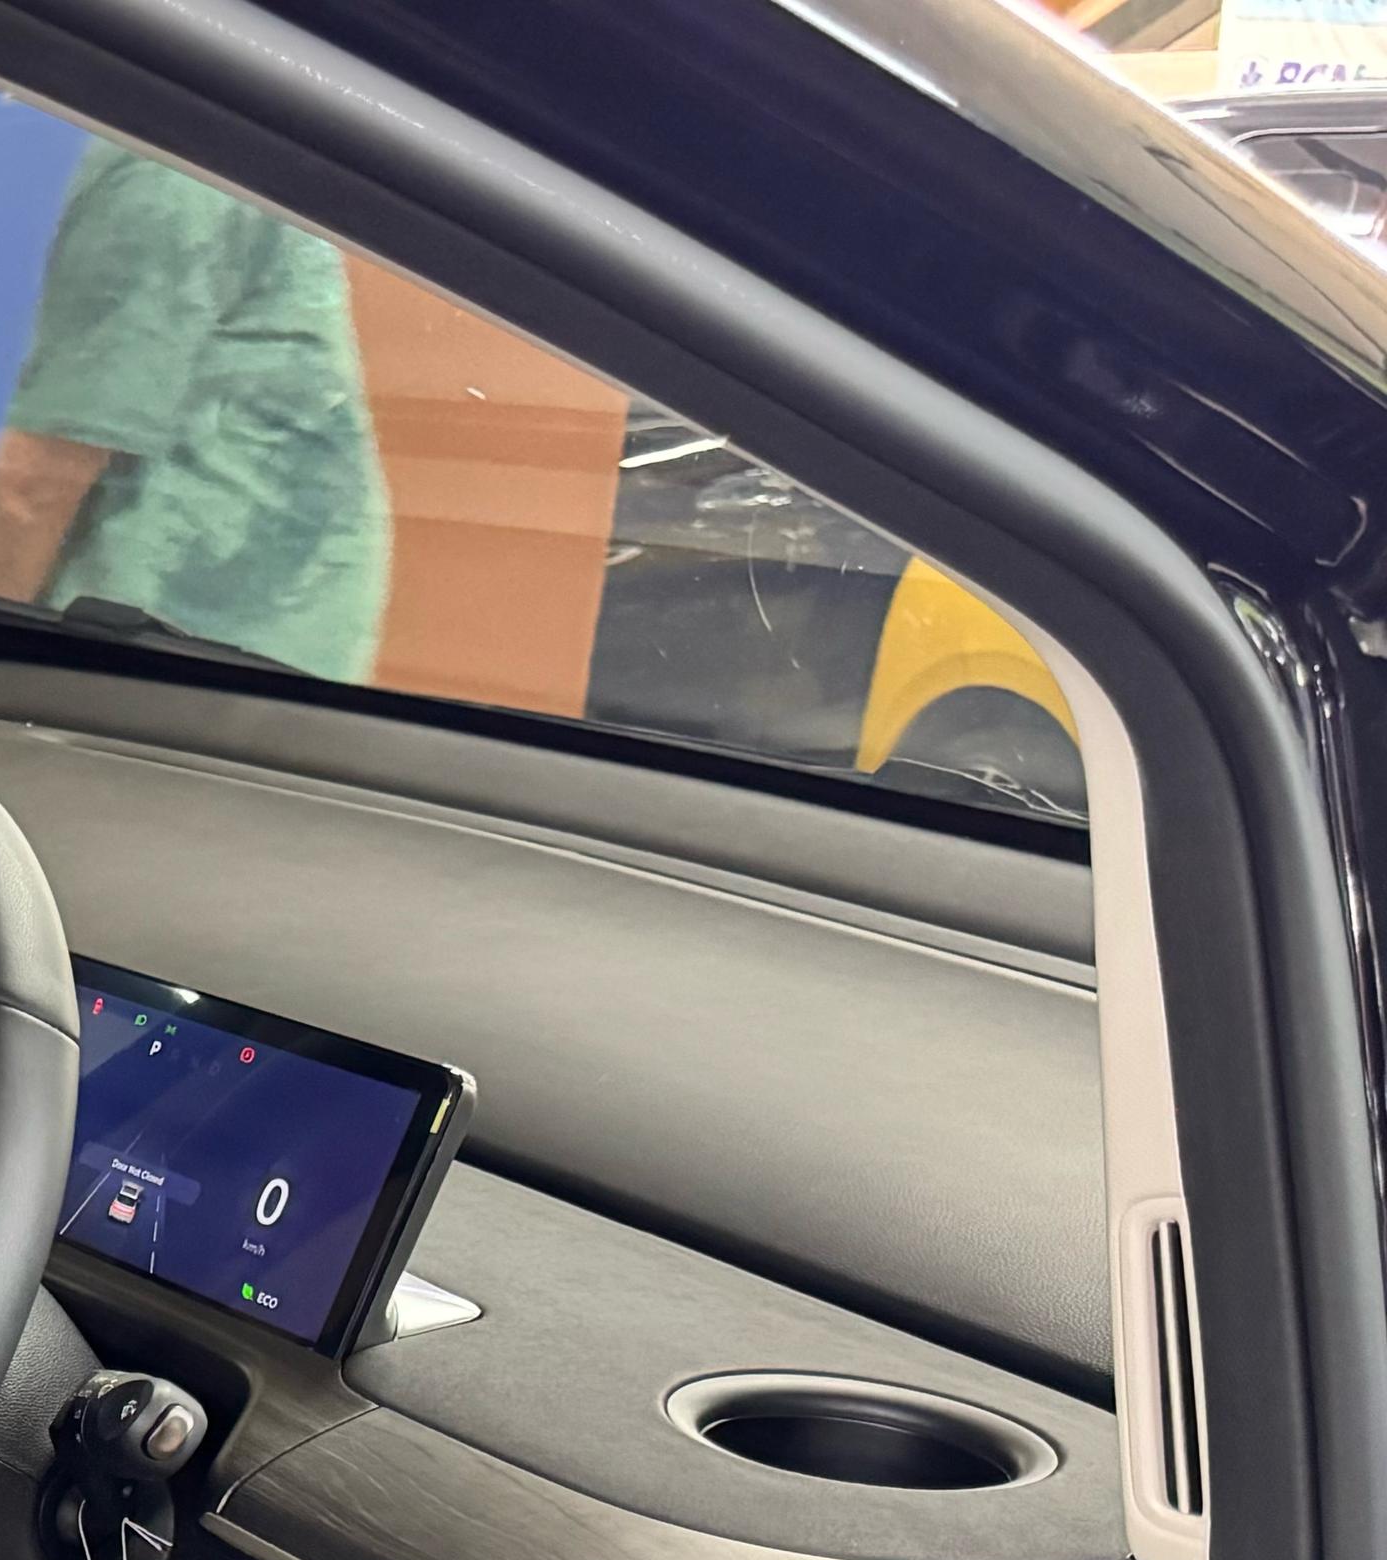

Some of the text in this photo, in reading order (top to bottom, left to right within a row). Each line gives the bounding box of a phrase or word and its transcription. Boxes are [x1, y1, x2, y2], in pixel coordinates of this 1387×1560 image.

[149, 1040, 162, 1056] P
[111, 1158, 165, 1186] Door Not Closed
[256, 1178, 289, 1226] 0
[256, 1291, 278, 1309] ECO
